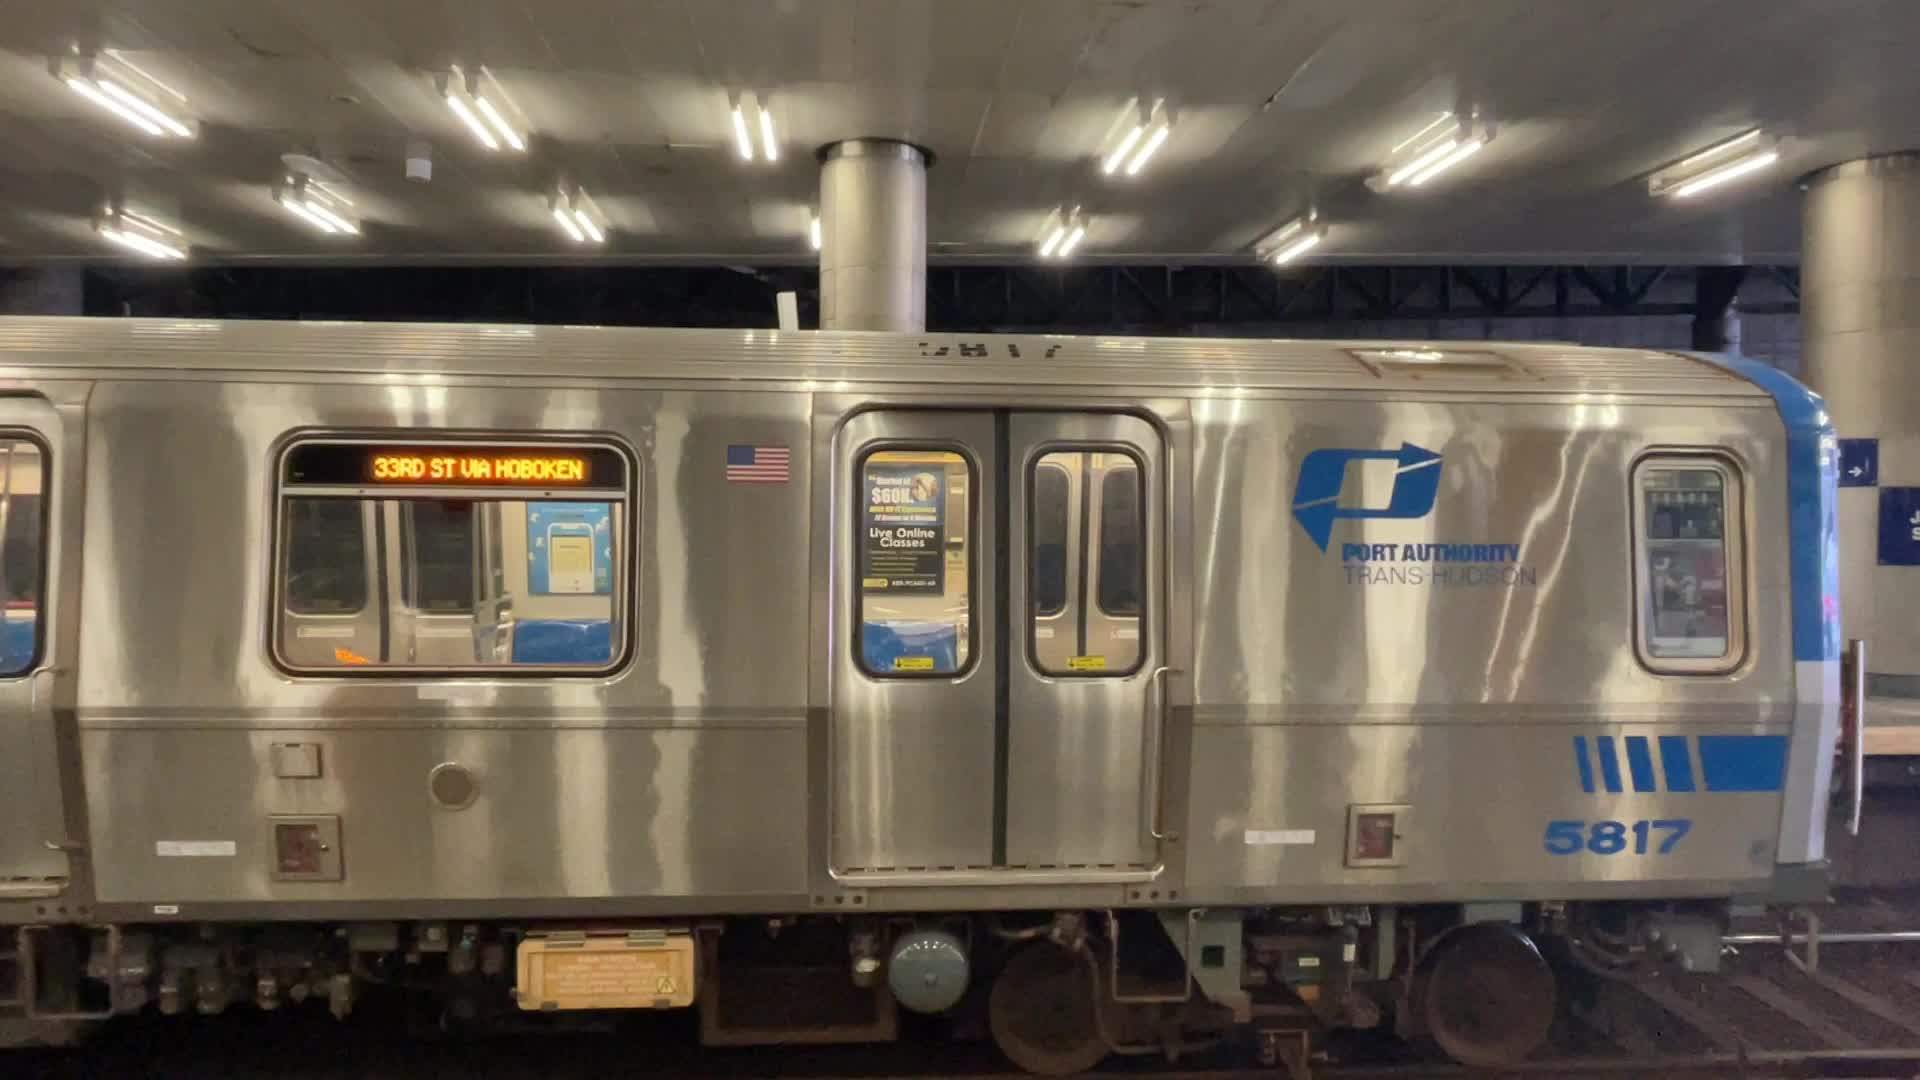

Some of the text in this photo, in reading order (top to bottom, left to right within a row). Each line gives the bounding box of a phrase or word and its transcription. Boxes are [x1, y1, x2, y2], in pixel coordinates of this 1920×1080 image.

[373, 457, 584, 480] 33RD ST VIA HOBOKEN
[869, 527, 935, 539] Live Online
[879, 538, 925, 548] Classes
[1341, 543, 1521, 562] PORT AUTHORITY
[1543, 819, 1694, 855] 5817
